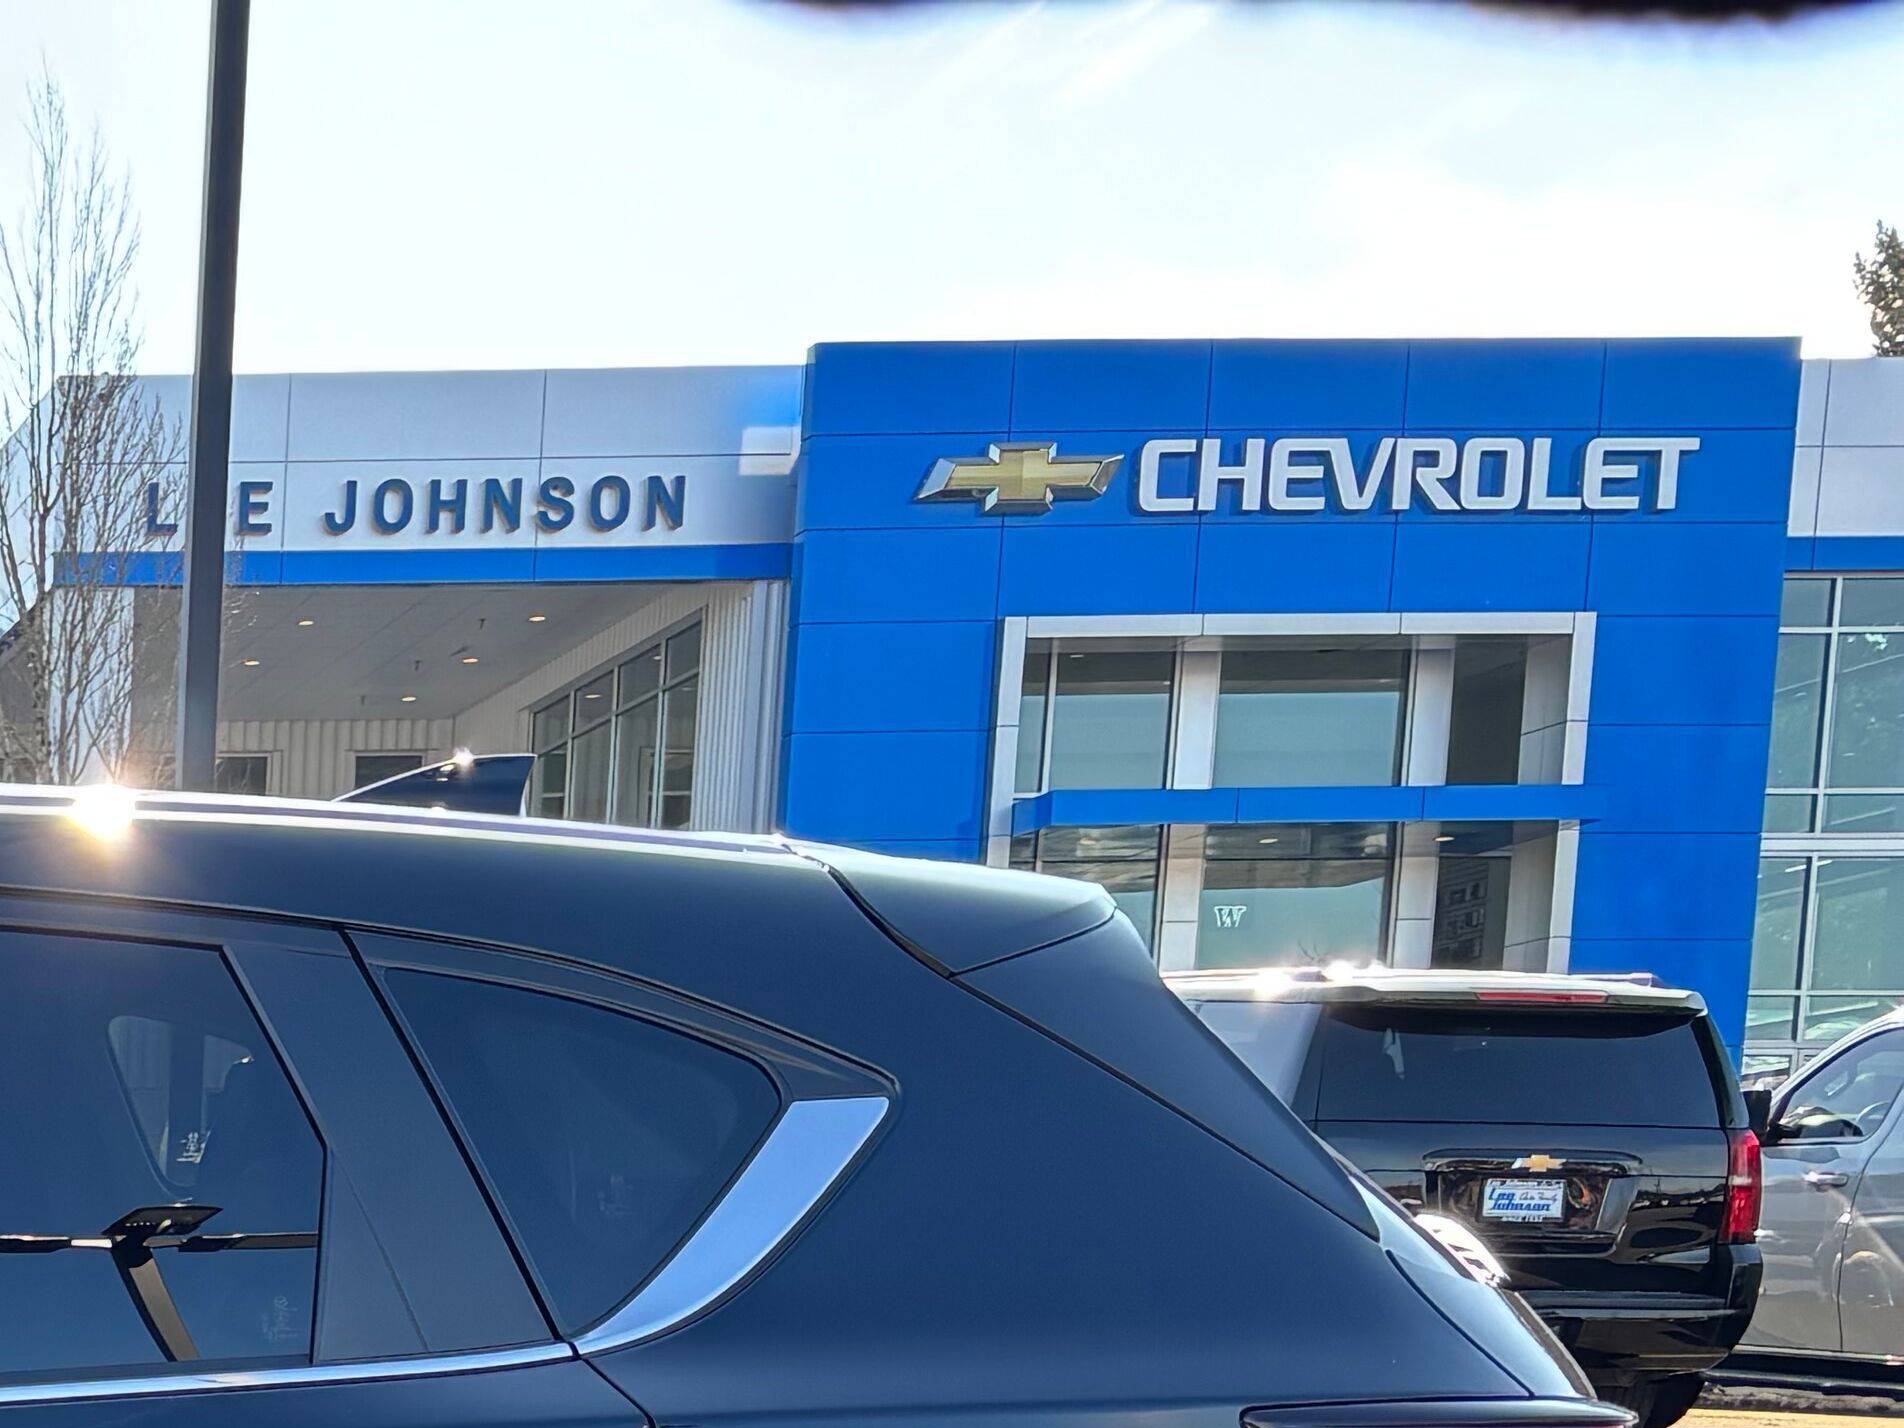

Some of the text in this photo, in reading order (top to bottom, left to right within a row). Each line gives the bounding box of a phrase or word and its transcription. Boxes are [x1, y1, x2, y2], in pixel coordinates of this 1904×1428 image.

[145, 475, 687, 536] LE JOHNSON
[1139, 437, 1701, 512] CHEVROLET
